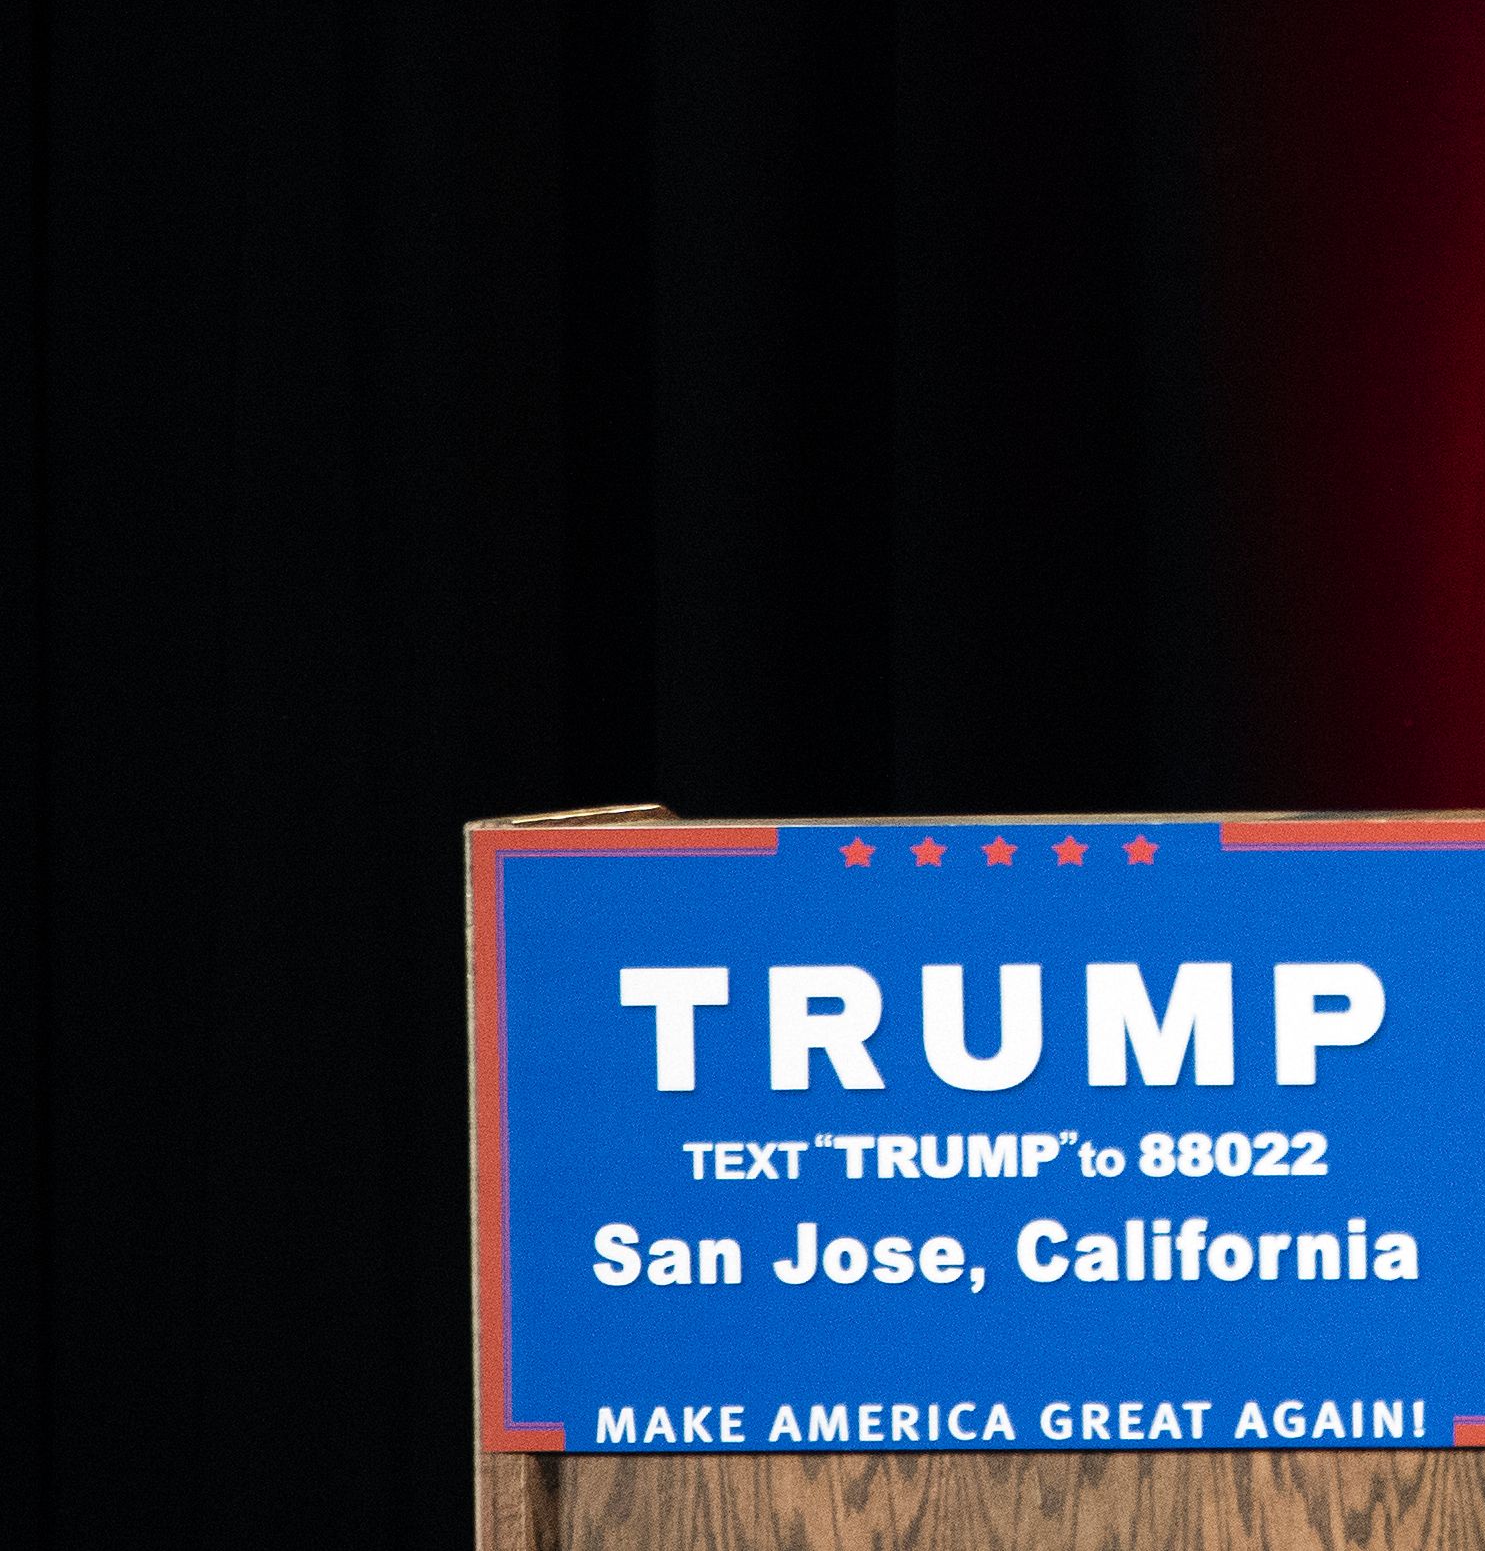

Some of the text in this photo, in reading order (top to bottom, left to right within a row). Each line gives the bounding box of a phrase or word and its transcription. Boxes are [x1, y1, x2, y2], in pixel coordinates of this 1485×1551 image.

[620, 963, 1386, 1091] TRUMP
[683, 1141, 808, 1180] TEXT
[1078, 1141, 1126, 1178] to
[1139, 1132, 1328, 1177] 88022
[593, 1217, 1418, 1293] San Jose, California
[596, 1399, 1425, 1443] MAKE AMERICA GREAT AGAIN!
